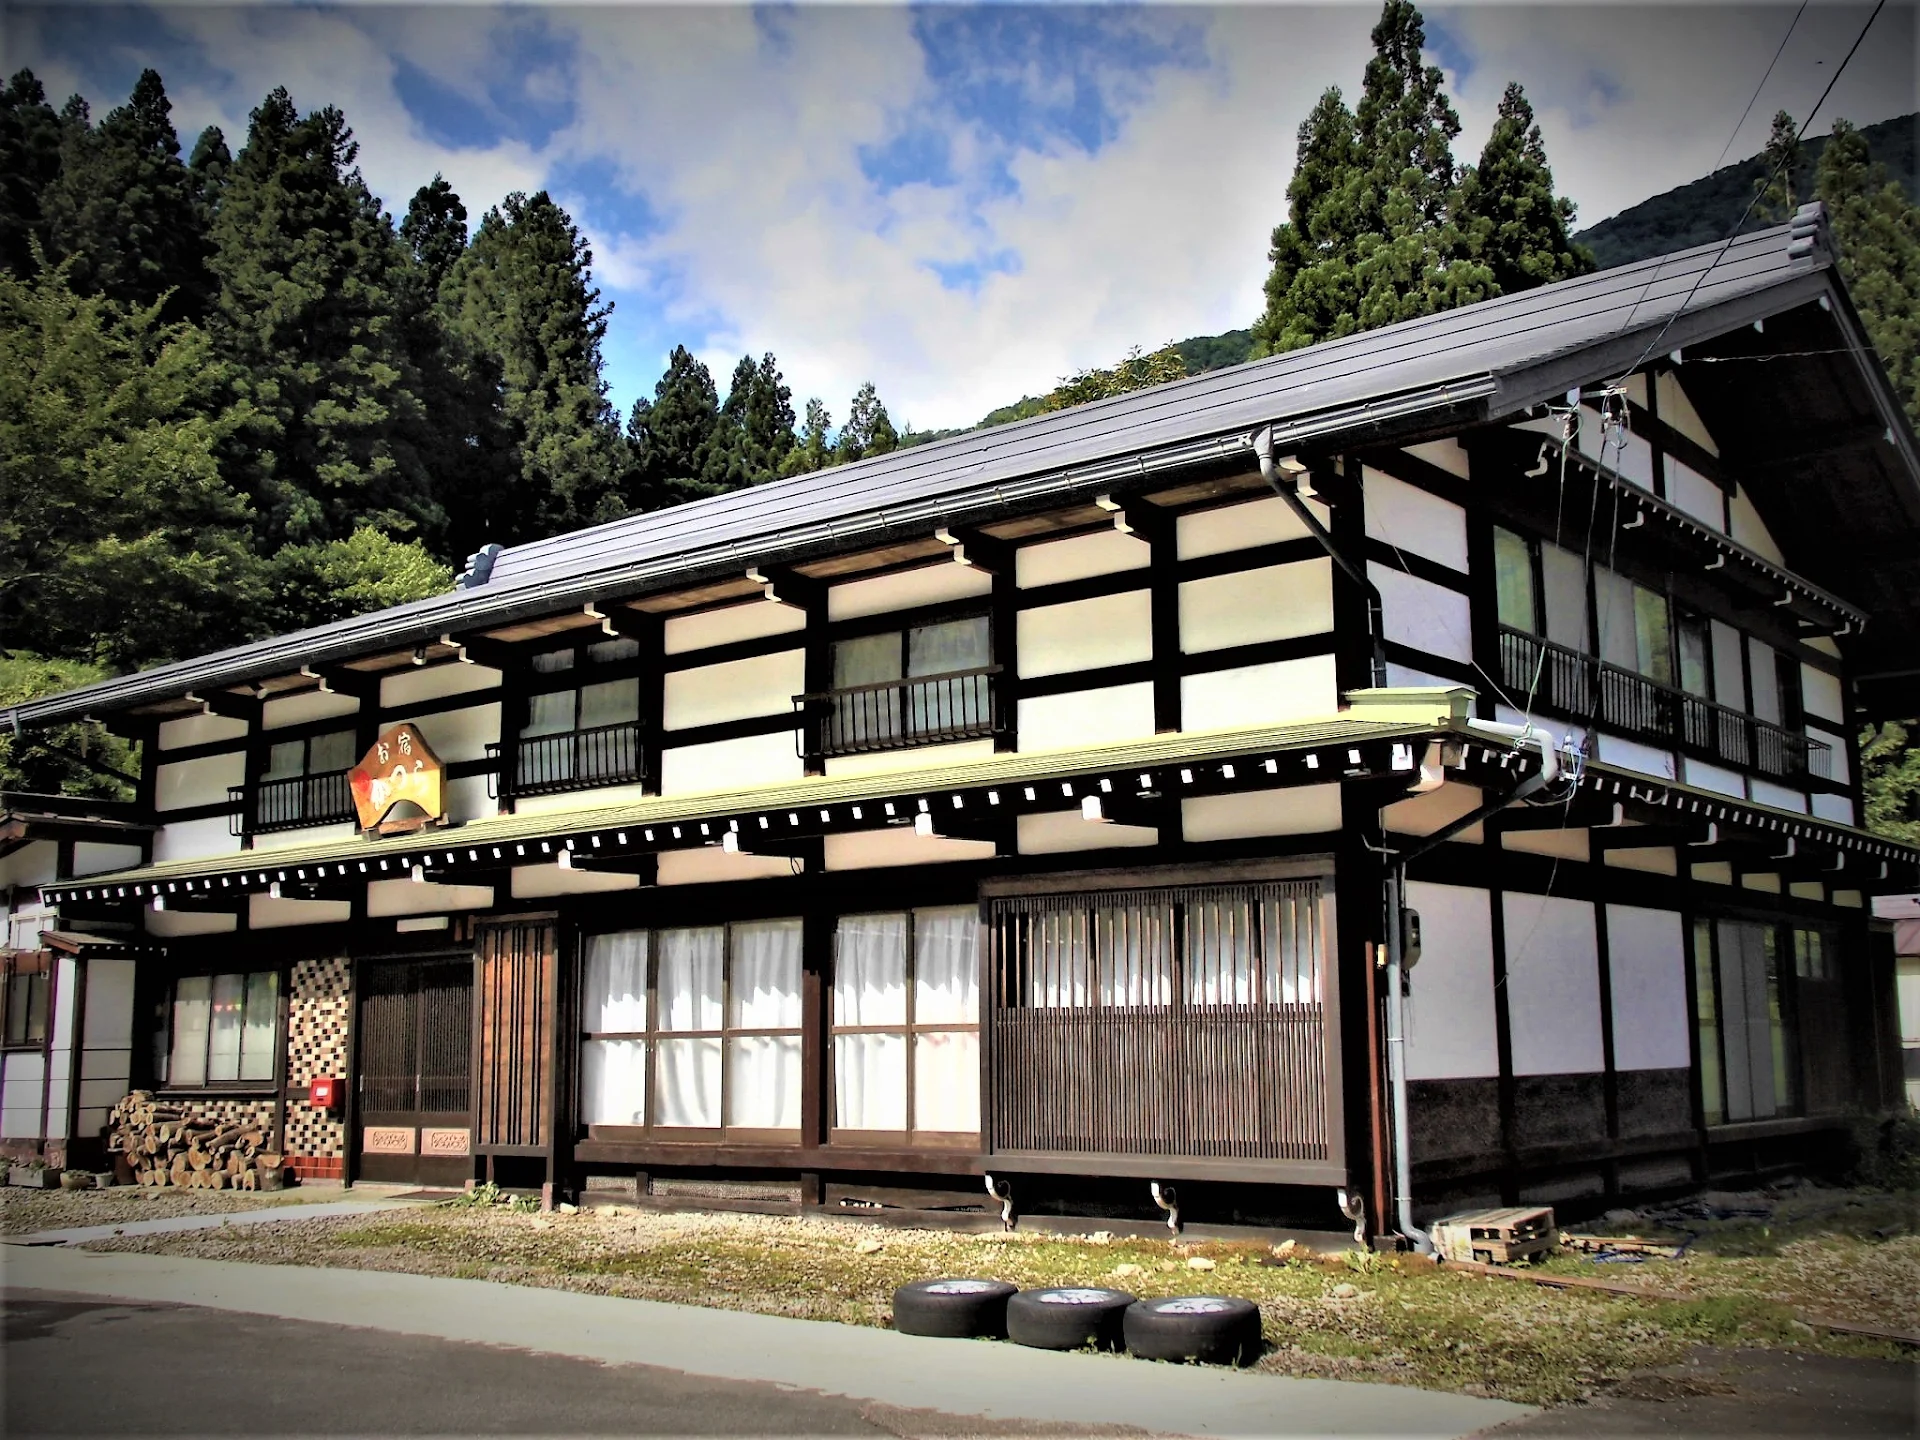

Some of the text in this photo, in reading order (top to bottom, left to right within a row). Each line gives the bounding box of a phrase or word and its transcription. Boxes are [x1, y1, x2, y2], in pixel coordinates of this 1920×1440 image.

[377, 732, 411, 764] お宿
[370, 760, 429, 811] かつら
